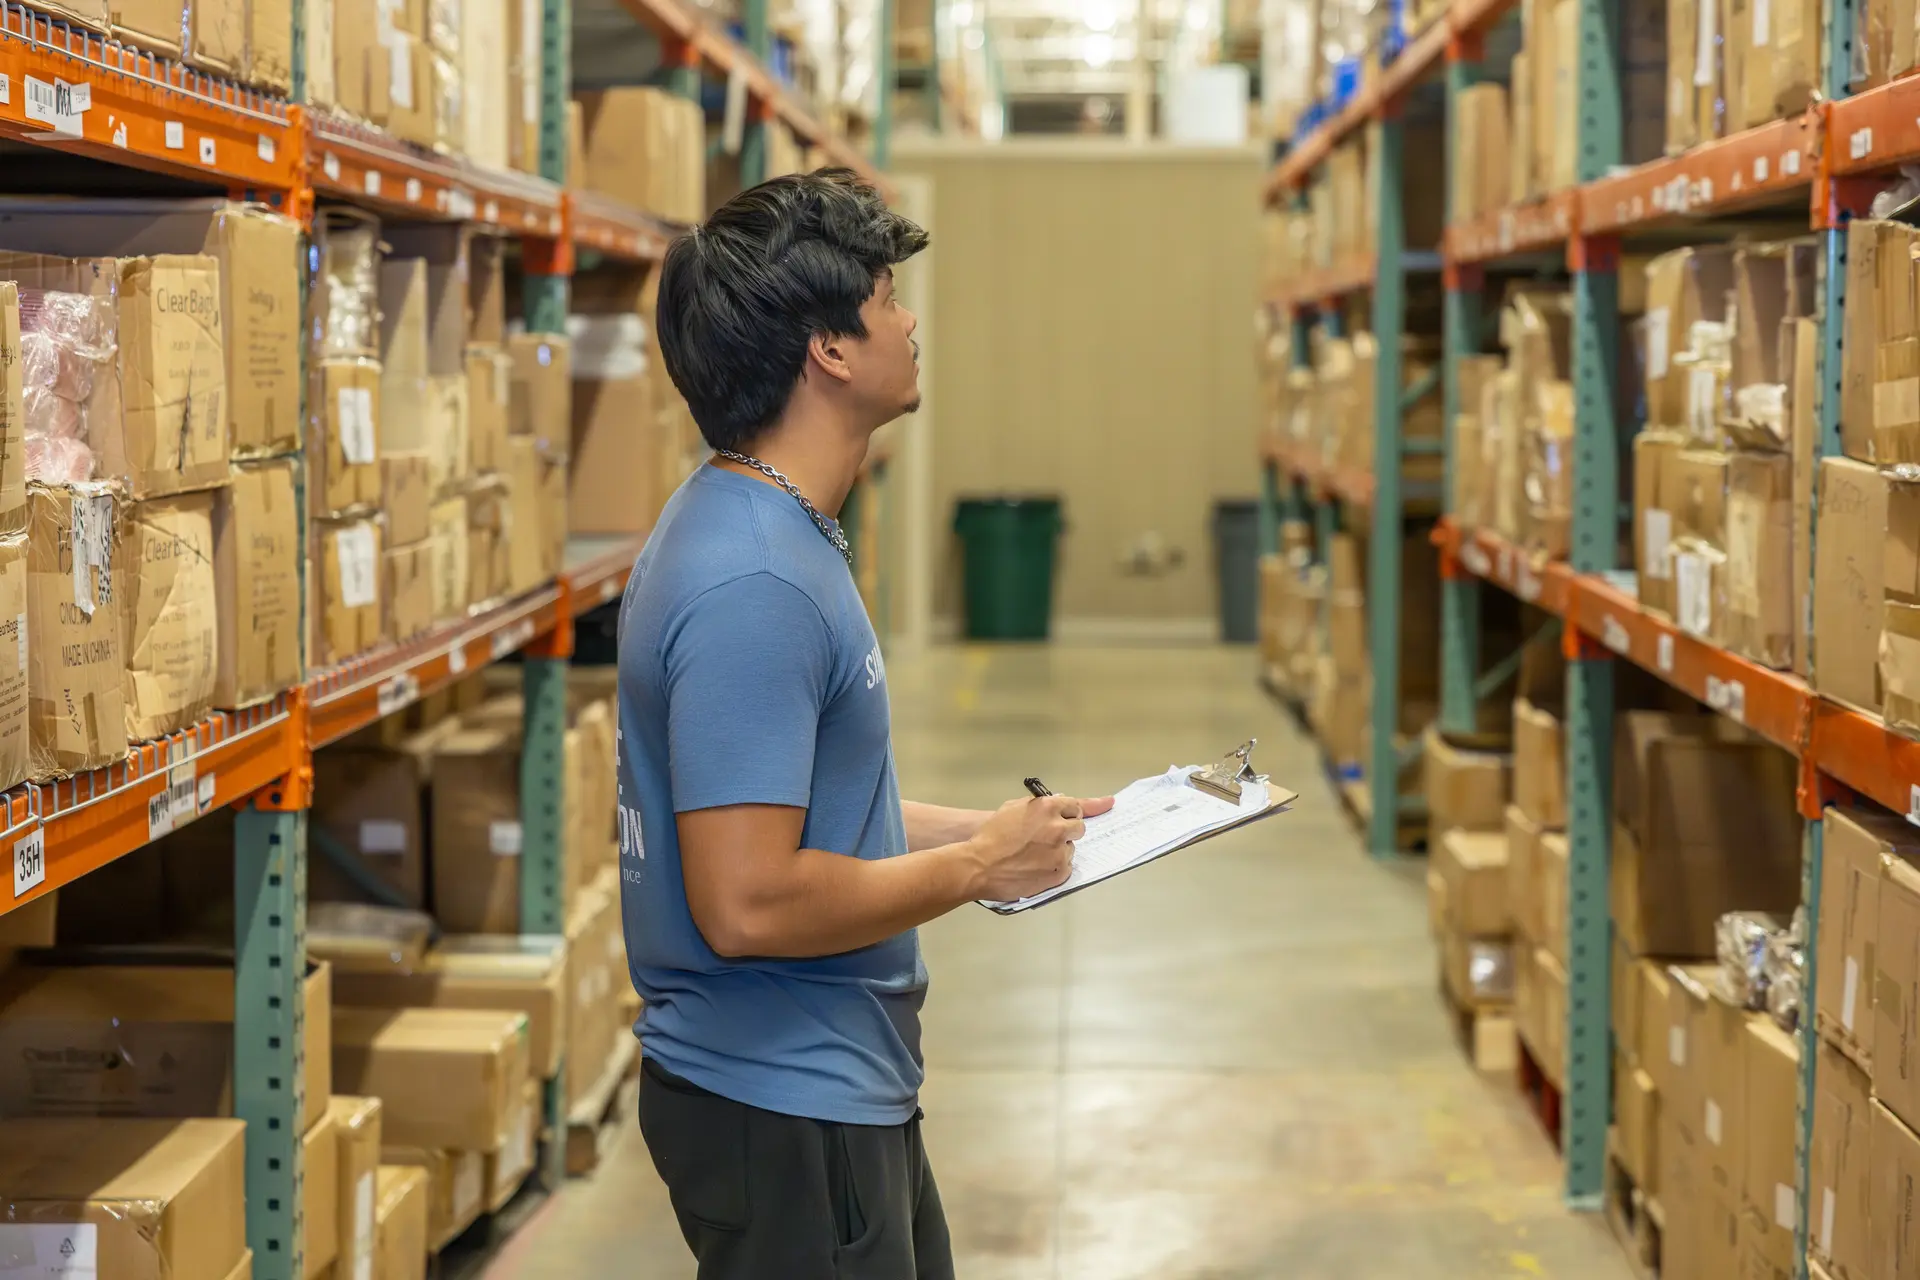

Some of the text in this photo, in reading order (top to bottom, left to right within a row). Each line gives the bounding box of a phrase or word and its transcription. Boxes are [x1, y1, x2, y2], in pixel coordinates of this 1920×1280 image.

[62, 638, 111, 668] MADE IN CHINA
[19, 840, 41, 882] 35H
